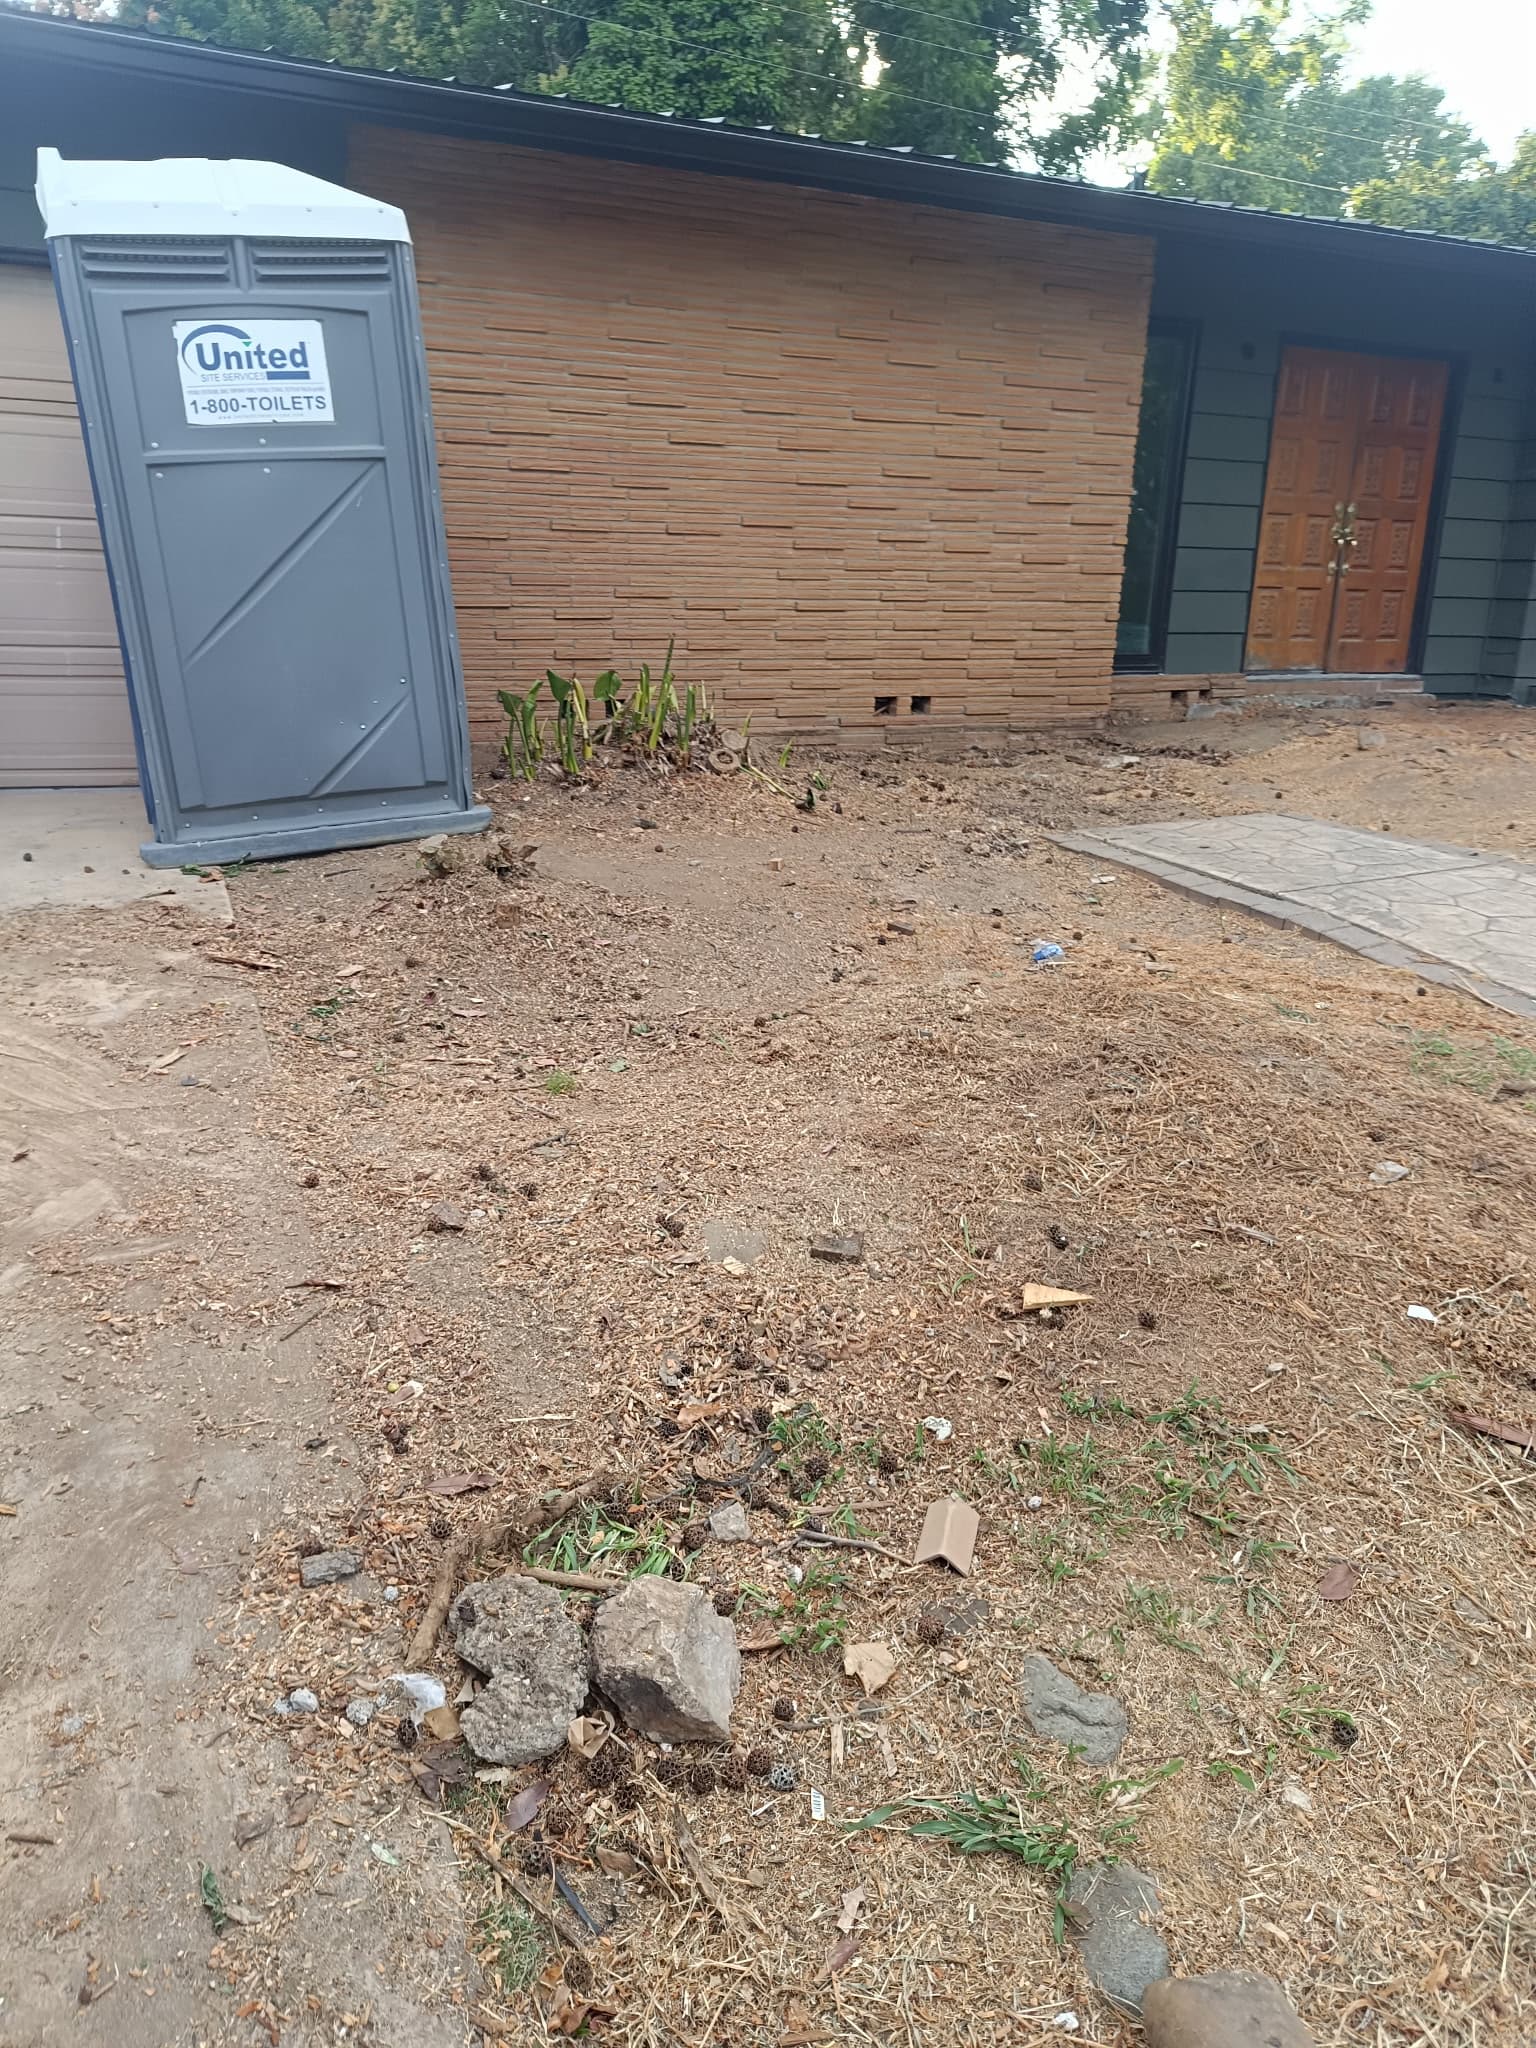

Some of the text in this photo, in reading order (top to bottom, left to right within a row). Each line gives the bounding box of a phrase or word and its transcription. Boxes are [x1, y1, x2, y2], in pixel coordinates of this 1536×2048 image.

[195, 341, 309, 371] United
[201, 372, 266, 383] SITE SERVICES
[190, 396, 326, 414] 1-800-TOILETS
